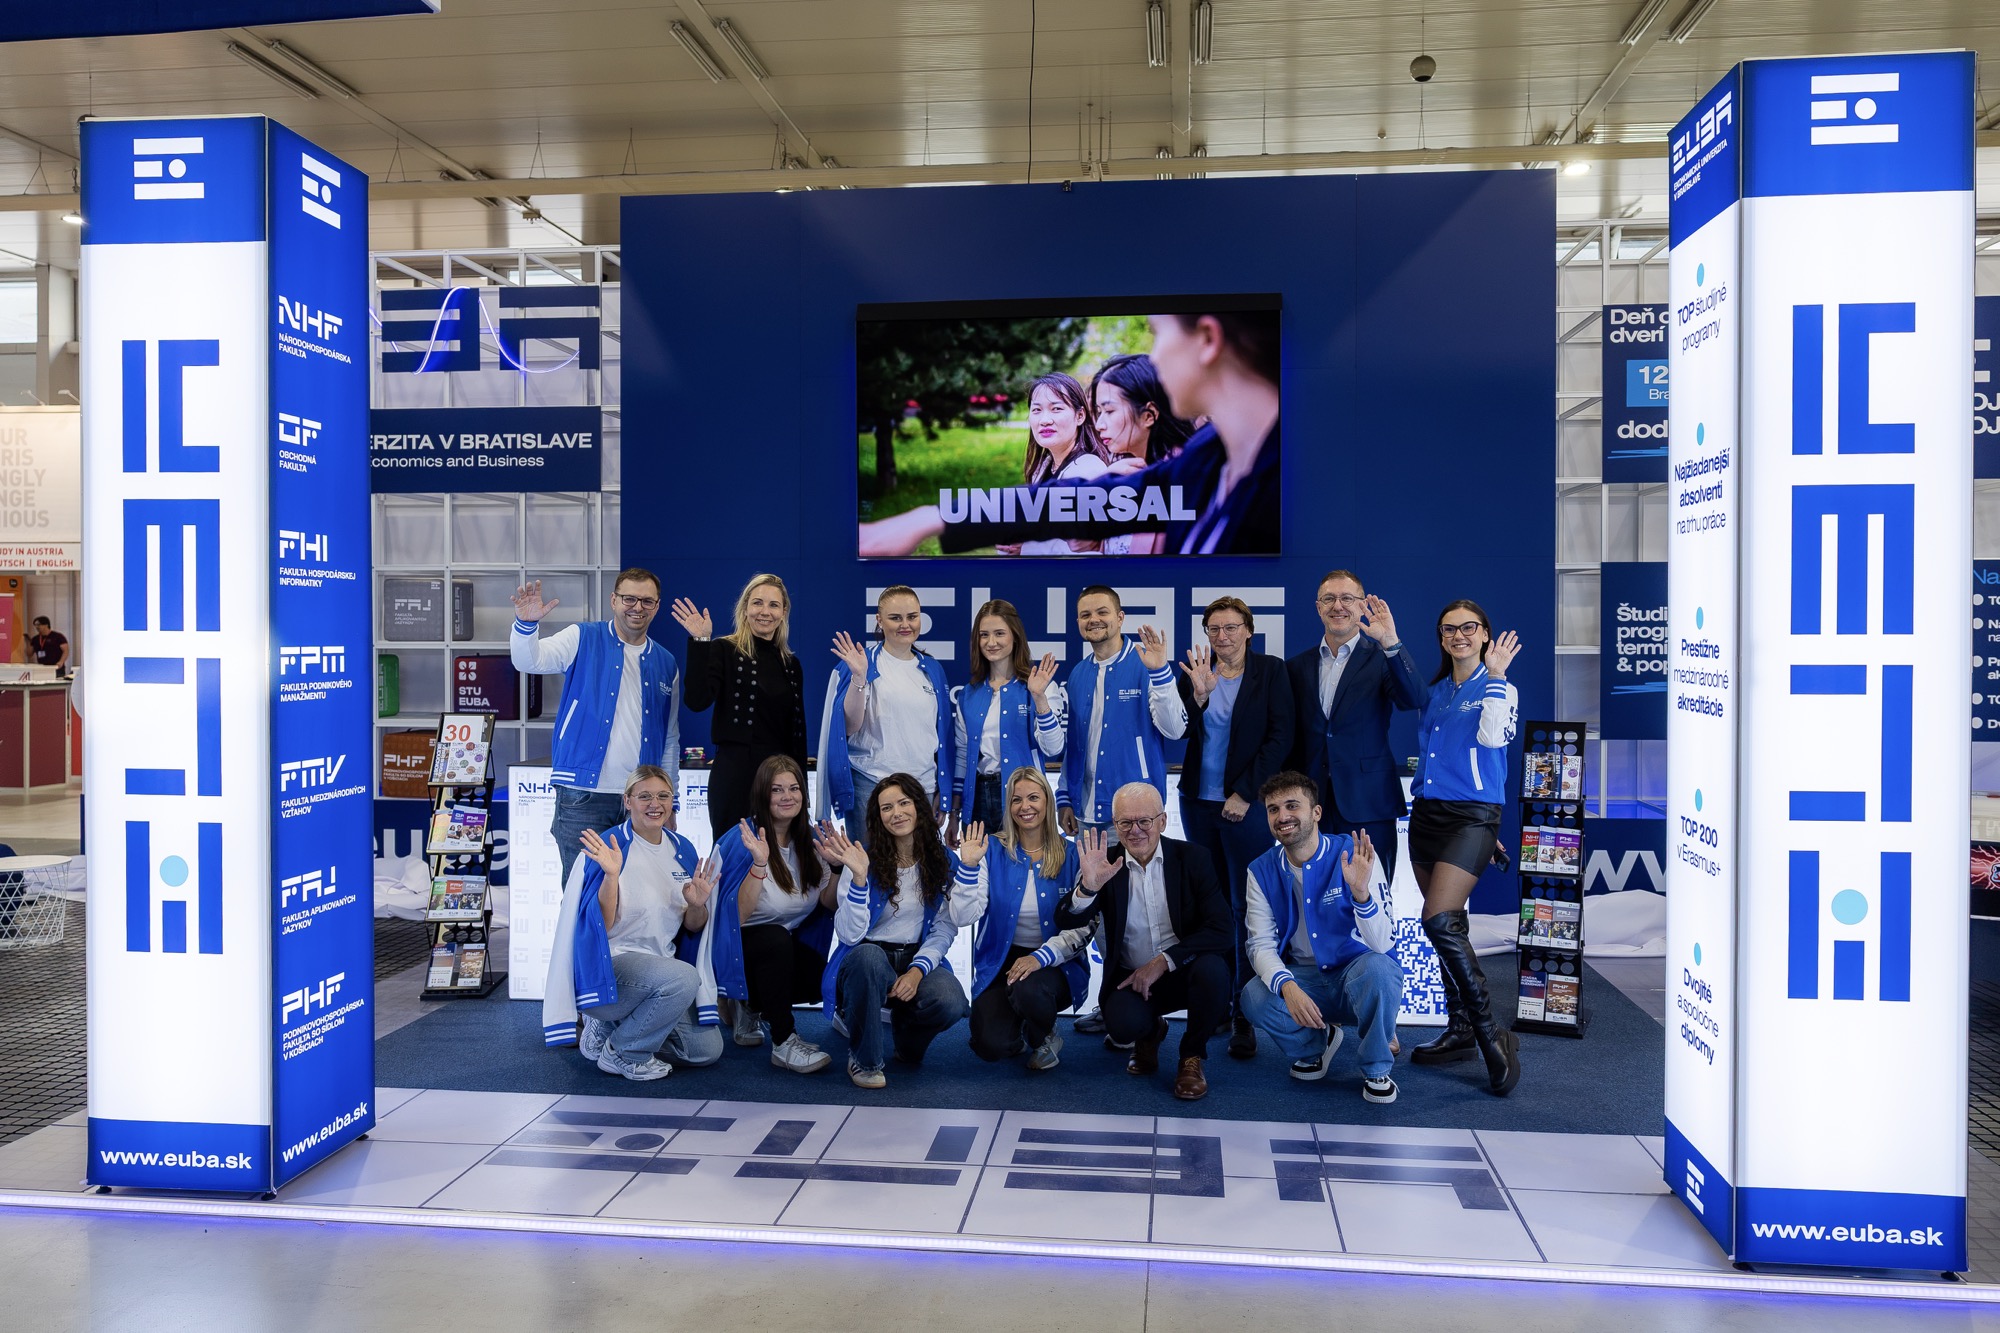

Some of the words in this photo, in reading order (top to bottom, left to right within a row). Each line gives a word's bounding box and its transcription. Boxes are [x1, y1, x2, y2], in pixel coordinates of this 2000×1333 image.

[1673, 159, 1701, 191] EKONOMICKÁ
[1700, 138, 1728, 167] UNIVERZITA
[1677, 171, 1701, 199] BRATISLAVE
[1677, 301, 1695, 326] TOP
[1695, 281, 1727, 316] študijné
[279, 295, 343, 340] NHF
[1610, 307, 1655, 325] Deň
[1609, 326, 1664, 344] dverí
[1682, 318, 1721, 355] programy
[279, 333, 351, 364] NÁRODOHOSPODÁRSKA
[279, 343, 307, 359] FAKULTA
[370, 434, 434, 450] RZITA
[439, 433, 455, 449] V
[460, 433, 593, 449] BRATISLAVE
[279, 450, 316, 464] OBCHODNÁ
[279, 460, 307, 472] FAKULTA
[370, 455, 443, 468] conomics
[446, 455, 475, 467] and
[478, 454, 545, 467] Business
[1675, 447, 1731, 483] Najžiadanejší
[939, 486, 1196, 524] UNIVERSAL
[1680, 480, 1723, 507] absolventi
[1677, 519, 1686, 534] na
[1687, 515, 1701, 533] trhu
[1702, 510, 1726, 534] práce
[15, 548, 25, 556] IN
[27, 547, 64, 556] AUSTRIA
[279, 529, 328, 562] FHI
[36, 559, 74, 567] ENGLISH
[280, 567, 307, 577] FAKULTA
[308, 569, 356, 580] HOSPODÁRSKEJ
[280, 577, 323, 588] INFORMATIKY
[1616, 602, 1668, 624] Študi
[280, 645, 345, 675] FPM
[1681, 638, 1720, 659] Prestížne
[1616, 657, 1633, 672] &
[280, 683, 308, 692] FAKULTA
[309, 679, 352, 690] PODNIKOVÉHO
[1673, 666, 1729, 689] medzinárodné
[280, 690, 326, 702] MANAŽMENTU
[458, 687, 482, 696] STU
[458, 697, 490, 706] EUBA
[1677, 693, 1724, 717] akreditácie
[444, 724, 471, 742] 30
[384, 754, 426, 767] PHF
[281, 754, 346, 792] FMV
[281, 796, 309, 808] FAKULTA
[309, 785, 366, 803] MEDZINÁRODNÝCH
[281, 806, 311, 819] VZŤAHOV
[1680, 815, 1698, 838] TOP
[1699, 824, 1718, 848] 200
[1677, 844, 1683, 858] v
[1682, 843, 1721, 876] Erasmus+
[281, 866, 336, 908] FAJ
[282, 909, 310, 925] FAKULTA
[310, 894, 356, 916] APLIKOVANÝCH
[282, 919, 312, 936] JAZYKOV
[1683, 967, 1712, 1003] Dvojité
[282, 971, 345, 1025] PHF
[1677, 994, 1683, 1008] a
[282, 998, 365, 1042] PODNIKOVOHOSPODÁRSKA
[283, 1033, 311, 1052] FAKULTA
[311, 1028, 321, 1040] SO
[321, 1016, 345, 1034] SÍDLOM
[1681, 1022, 1714, 1065] diplomy
[283, 1051, 289, 1061] V
[289, 1036, 324, 1058] KOŠICIACH
[282, 1101, 368, 1163] www.euba.sk
[100, 1150, 252, 1169] www.euba.sk
[1752, 1223, 1944, 1246] www.euba.sk
